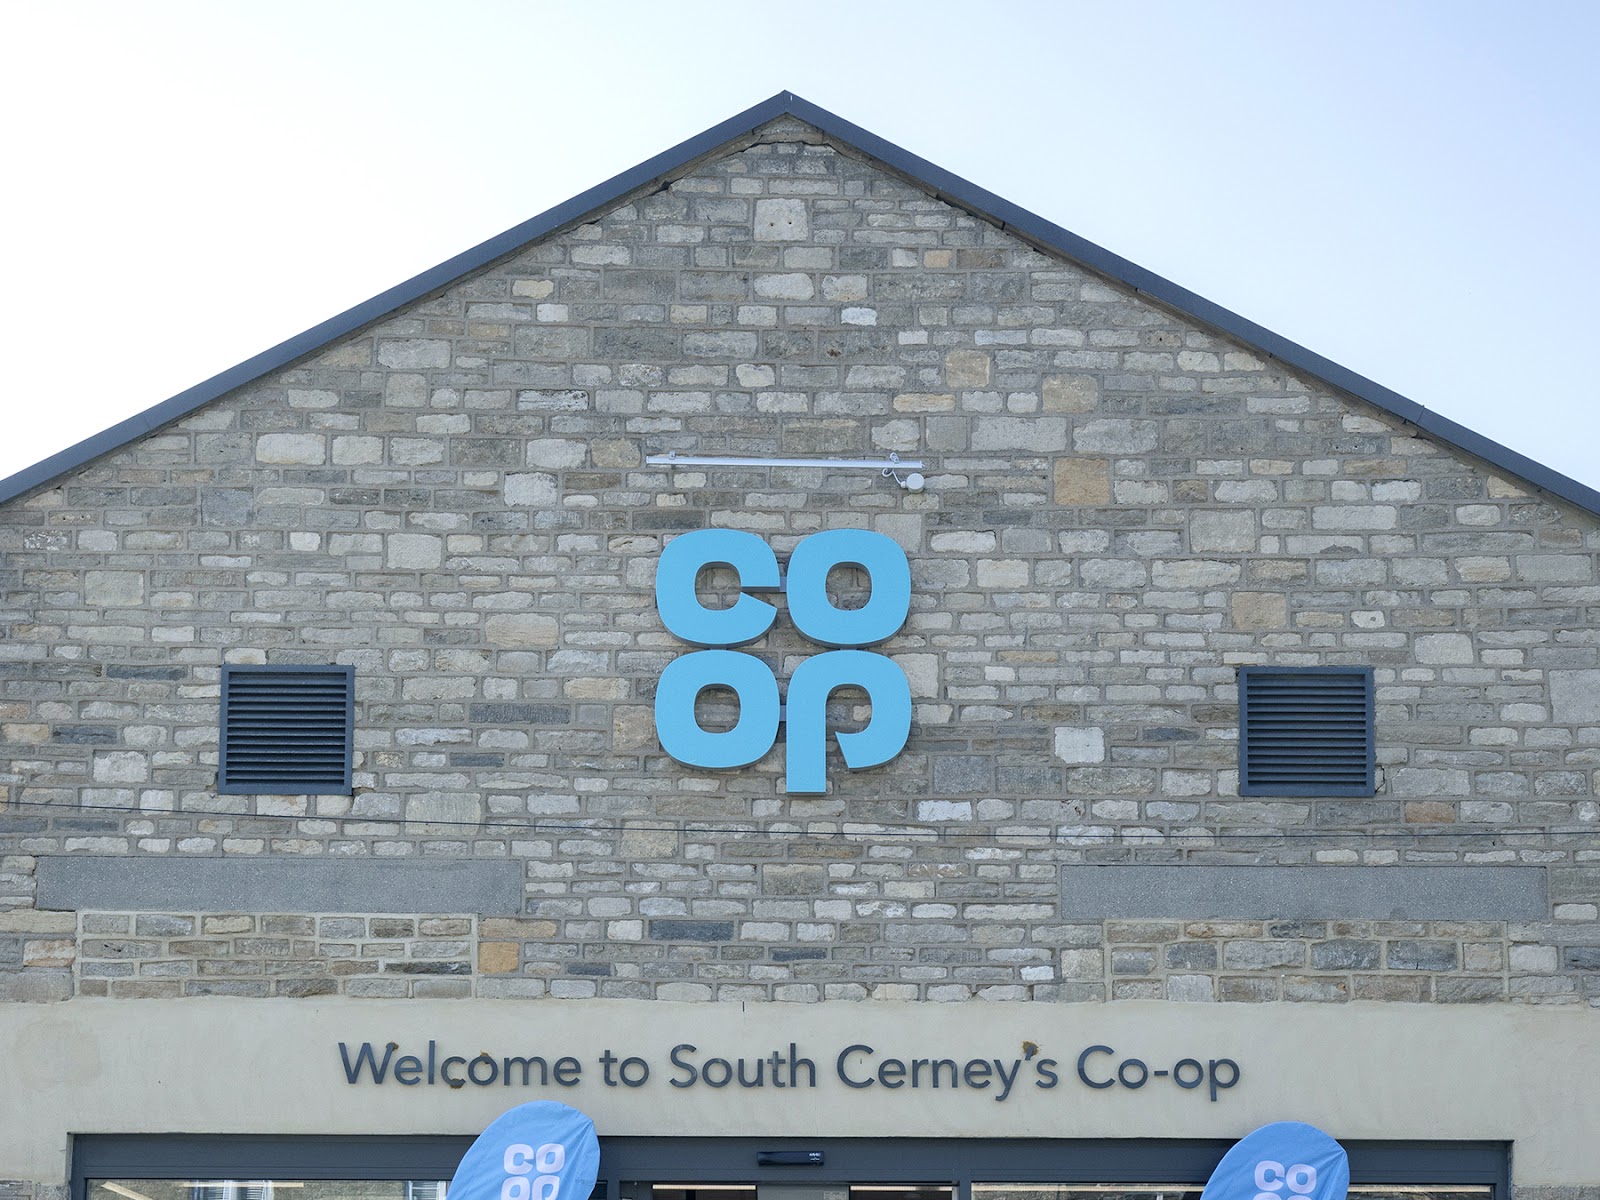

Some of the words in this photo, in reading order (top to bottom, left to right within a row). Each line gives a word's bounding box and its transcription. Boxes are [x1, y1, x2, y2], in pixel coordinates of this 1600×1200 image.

[338, 1040, 582, 1087] Welcome
[599, 1049, 650, 1087] to
[669, 1042, 817, 1088] South
[836, 1044, 1059, 1101] Cerney's
[1077, 1045, 1241, 1102] Co-op
